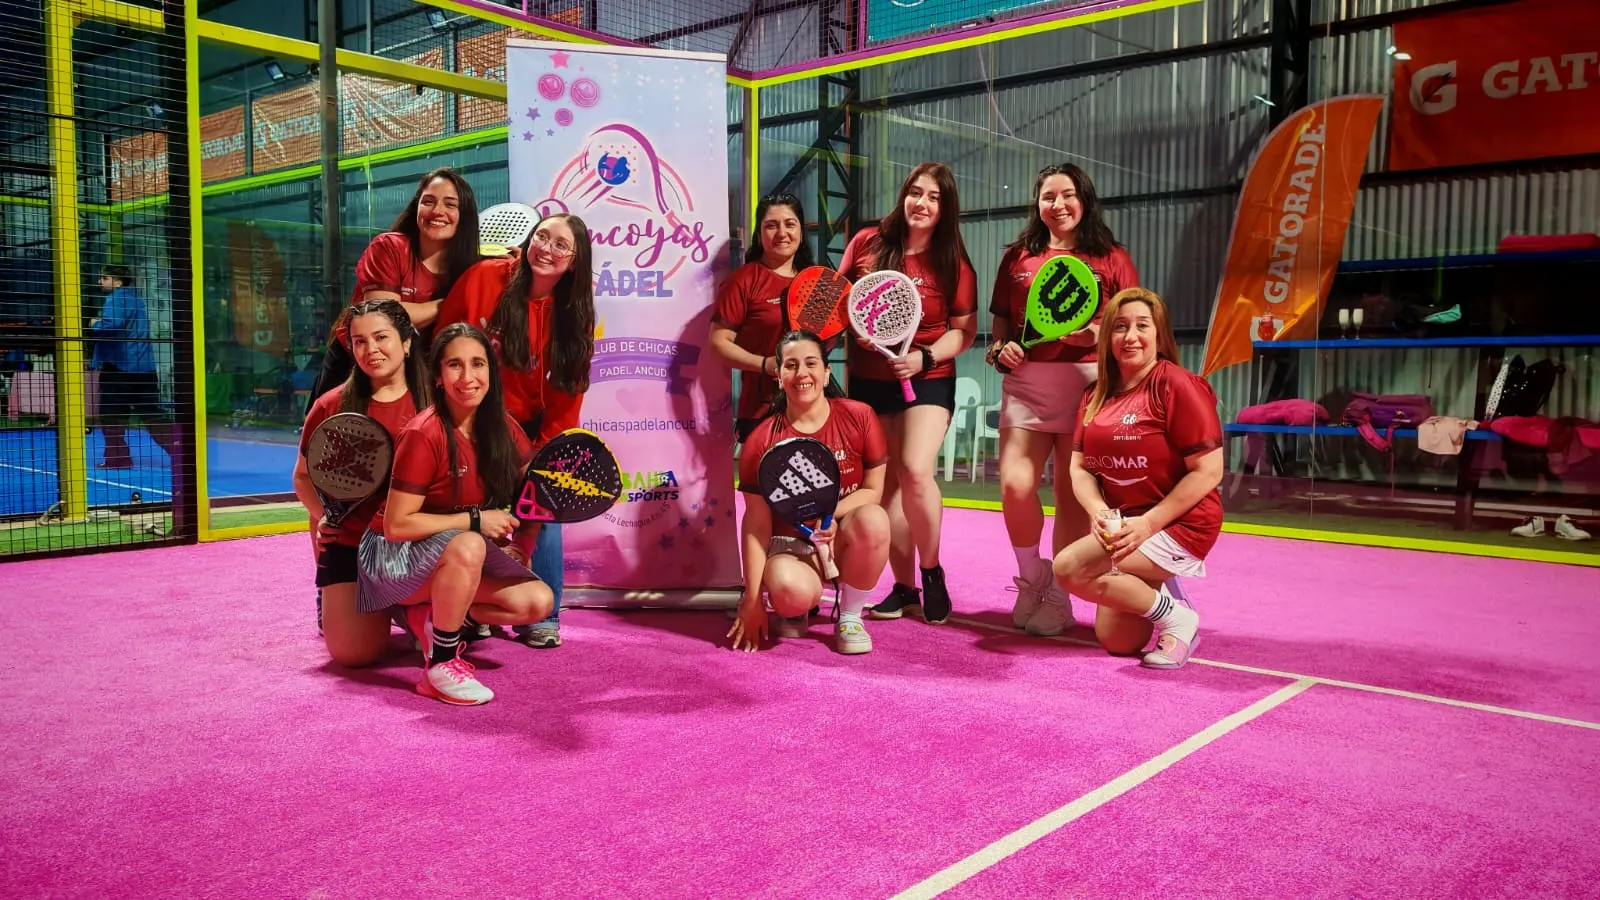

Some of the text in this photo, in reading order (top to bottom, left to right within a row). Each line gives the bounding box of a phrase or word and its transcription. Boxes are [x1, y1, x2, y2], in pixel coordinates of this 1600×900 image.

[1482, 52, 1600, 99] GAT
[1263, 123, 1325, 304] GATORADE
[535, 199, 715, 268] ncoyas
[595, 261, 673, 297] ÁDEL
[594, 341, 679, 355] LUB DE CHICAS
[599, 366, 667, 377] PADEL ANCUD
[582, 417, 697, 434] chicaspadelancud
